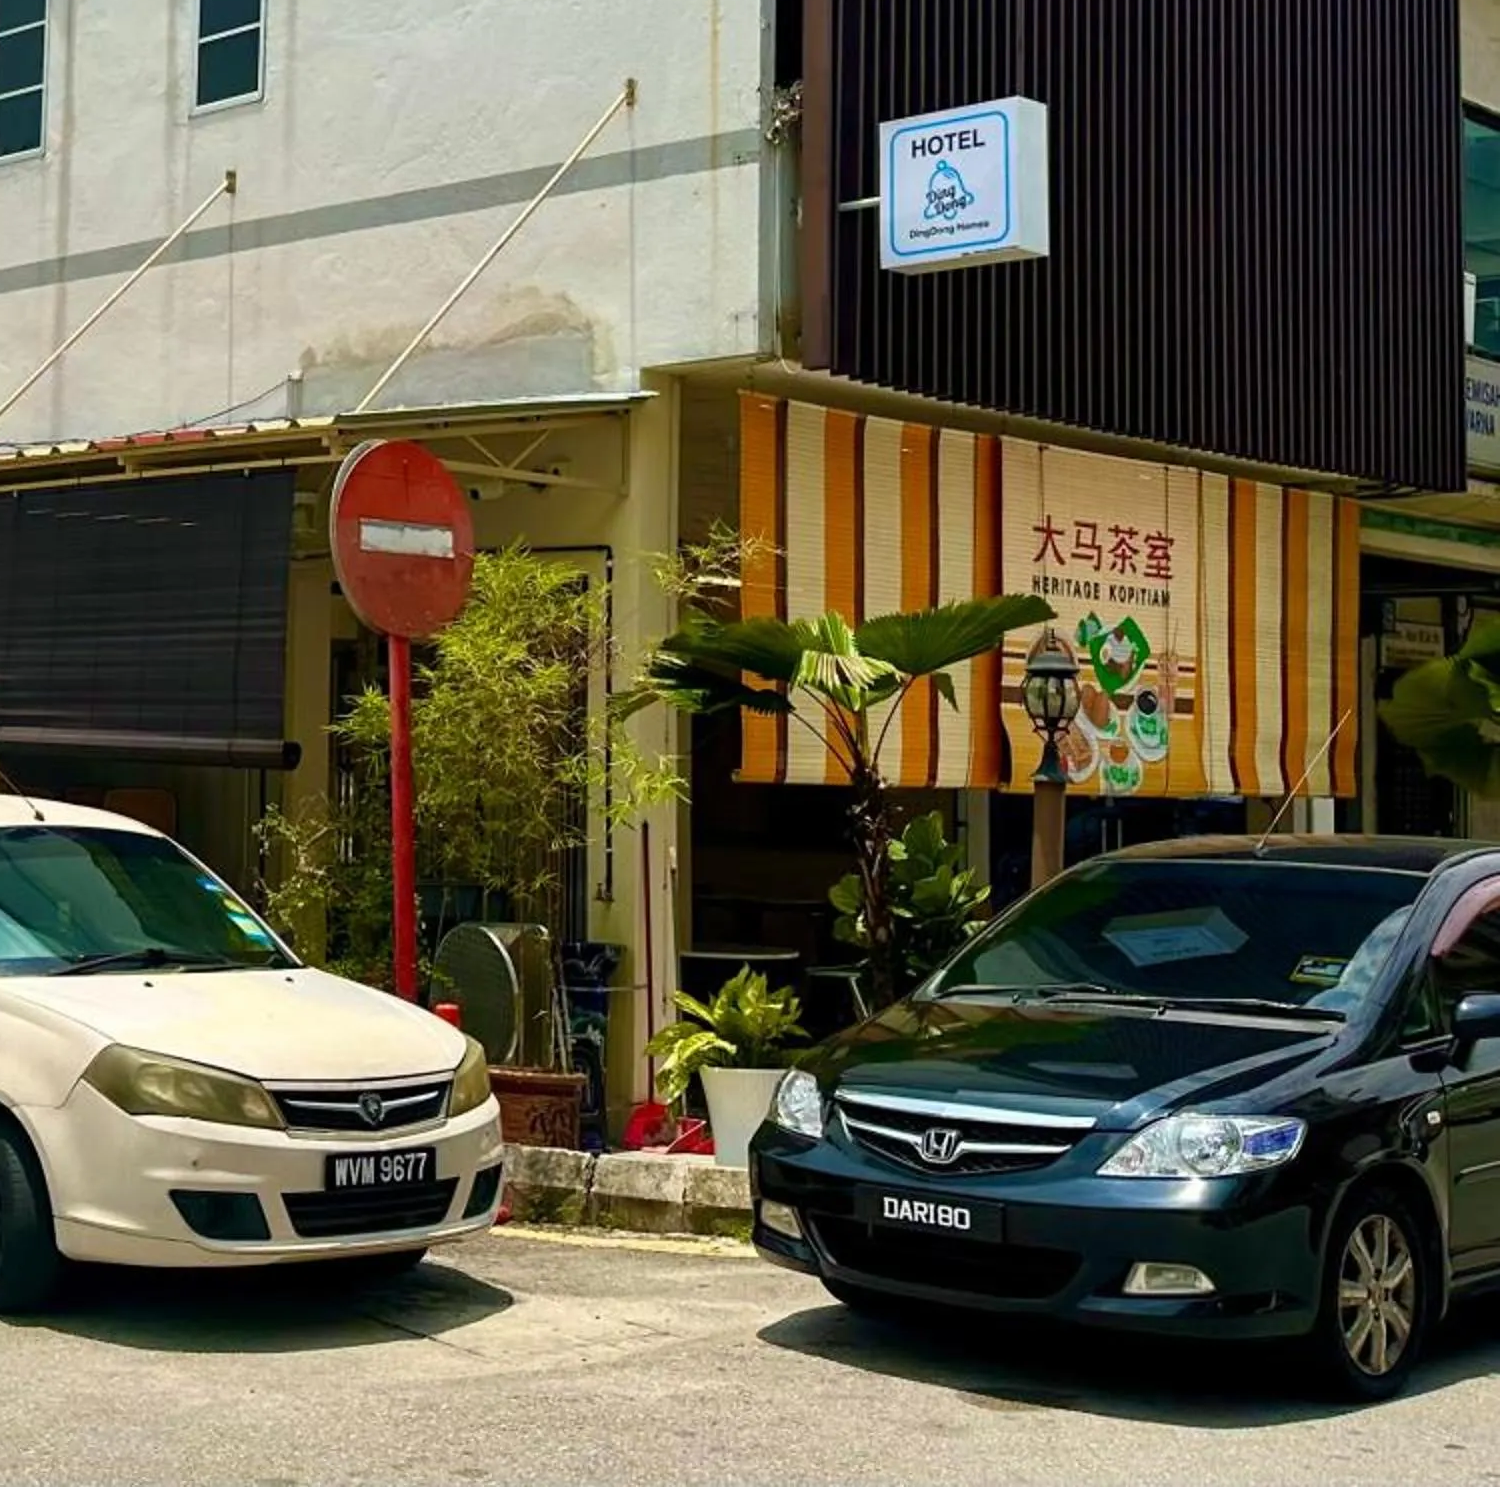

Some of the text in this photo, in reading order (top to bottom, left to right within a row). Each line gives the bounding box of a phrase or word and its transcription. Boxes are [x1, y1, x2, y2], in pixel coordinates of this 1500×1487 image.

[912, 129, 986, 158] HOTEL
[926, 185, 955, 204] Ding
[934, 196, 966, 215] Dong
[1032, 514, 1175, 580] 大马茶室
[1032, 575, 1171, 607] HERITAGE KOPITIAM
[335, 1152, 427, 1186] WVM 9677
